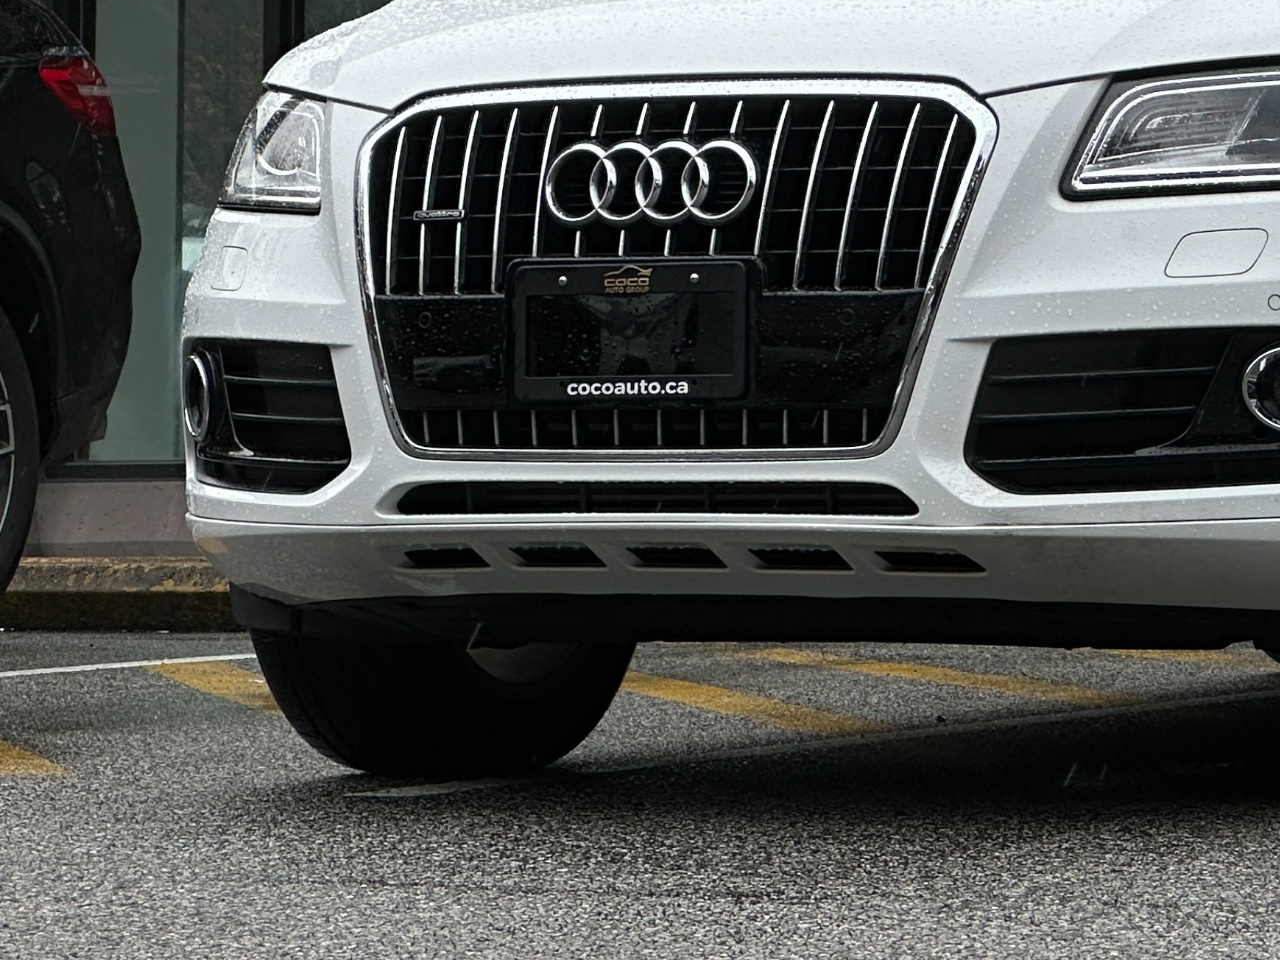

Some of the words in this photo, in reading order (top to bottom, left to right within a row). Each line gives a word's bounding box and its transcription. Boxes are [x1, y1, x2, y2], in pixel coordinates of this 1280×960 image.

[604, 277, 650, 286] COCO
[604, 286, 625, 294] AUTO
[625, 285, 651, 294] GROUP
[566, 379, 689, 396] cocoauto.ca
